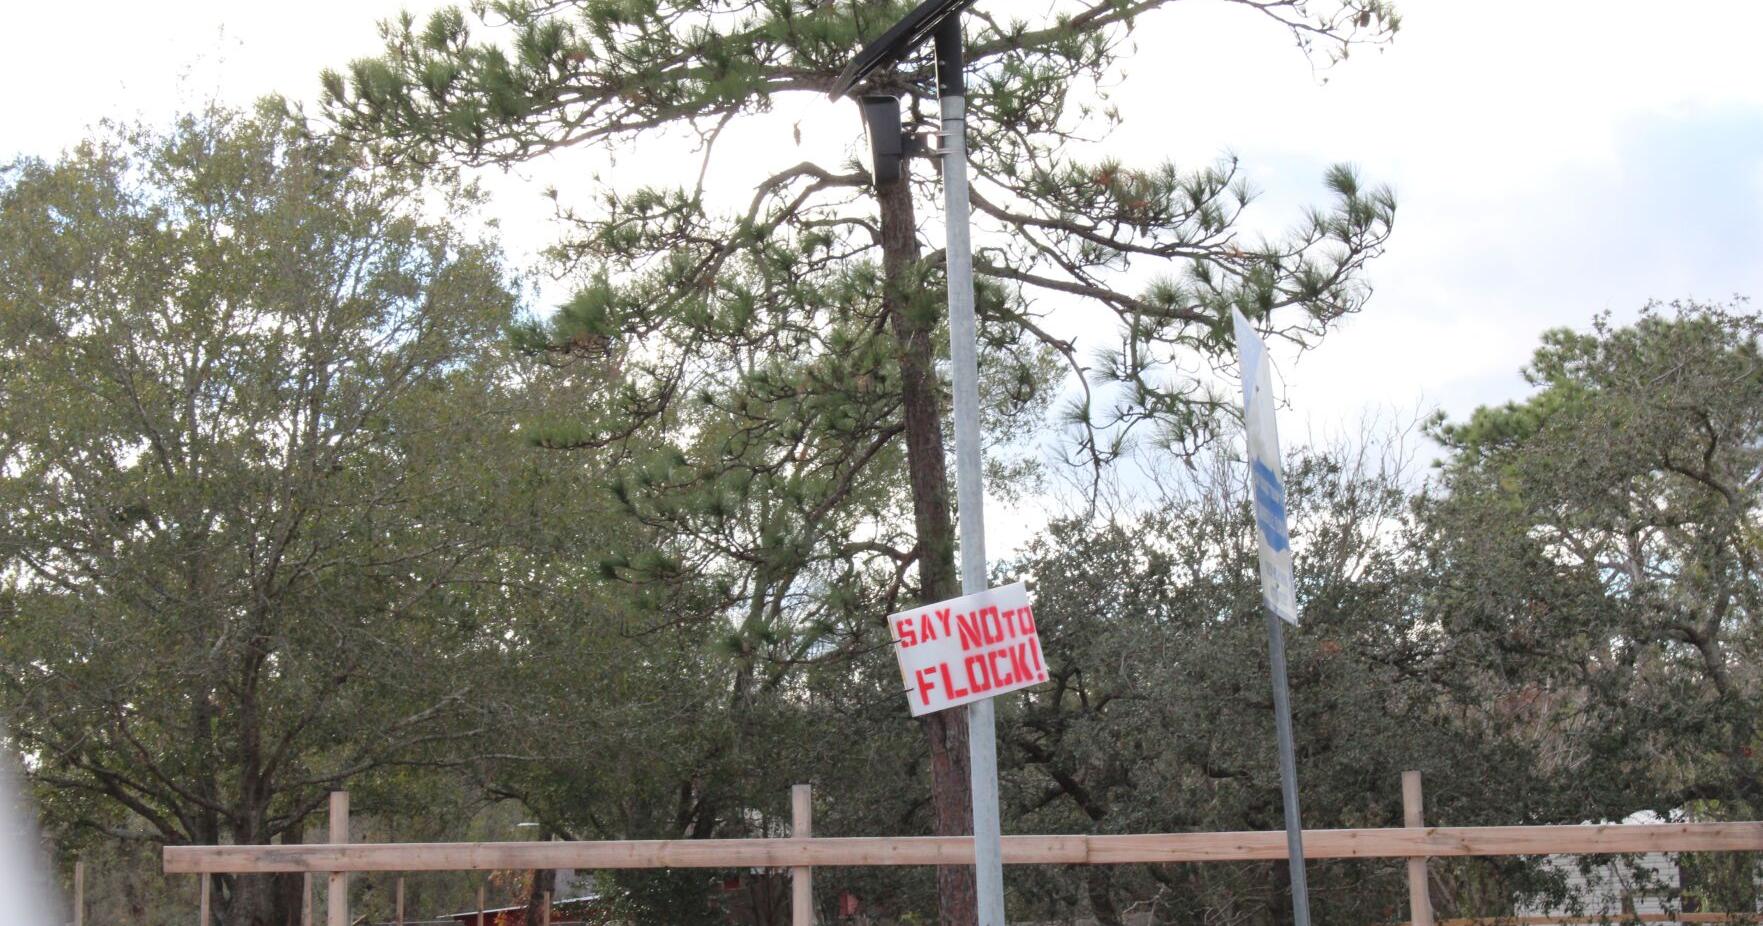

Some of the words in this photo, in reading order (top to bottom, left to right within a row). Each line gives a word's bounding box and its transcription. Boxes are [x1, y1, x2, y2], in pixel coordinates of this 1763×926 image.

[896, 608, 951, 648] SAY
[956, 606, 1005, 651] NO
[1002, 606, 1036, 638] TO
[915, 638, 1044, 706] FLOCK!
